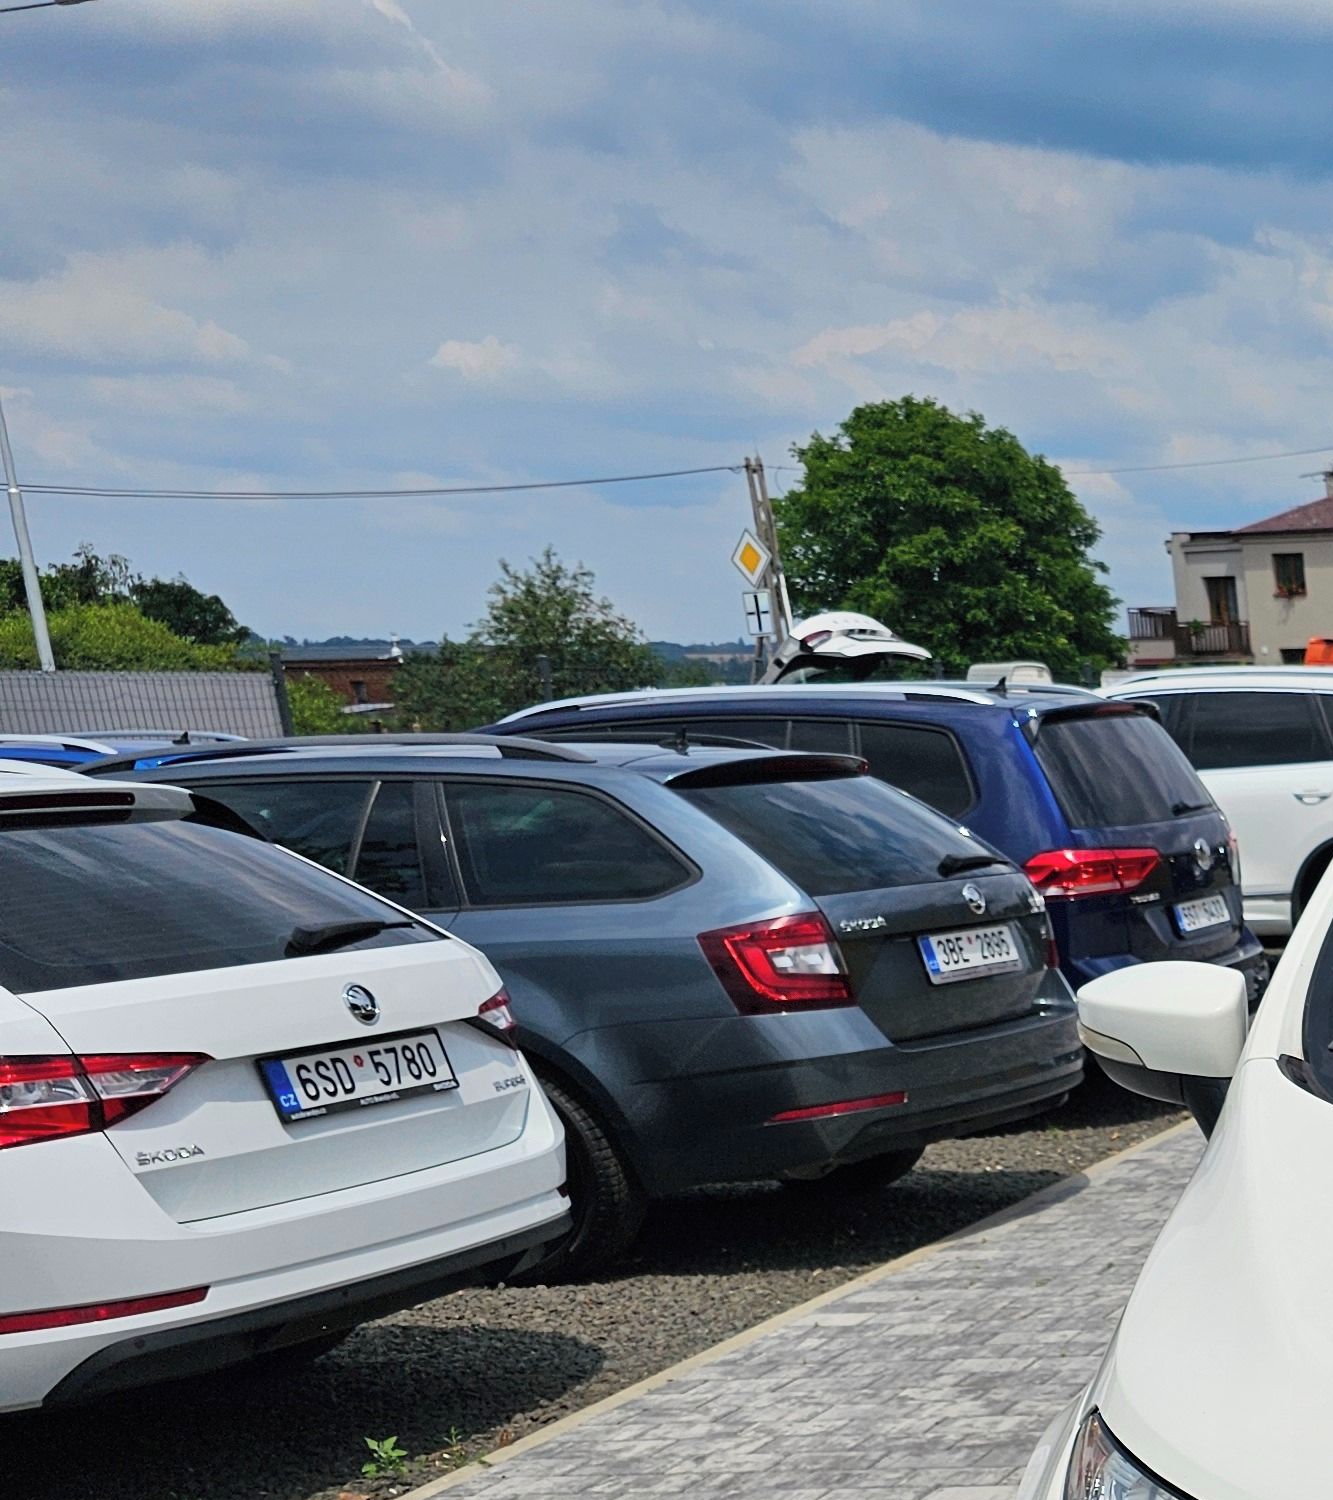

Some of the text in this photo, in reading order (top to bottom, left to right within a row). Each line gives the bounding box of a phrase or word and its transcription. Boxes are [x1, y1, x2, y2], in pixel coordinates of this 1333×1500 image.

[937, 936, 970, 966] 3BE
[295, 1042, 437, 1101] 6SD 5780
[279, 1093, 298, 1108] CZ
